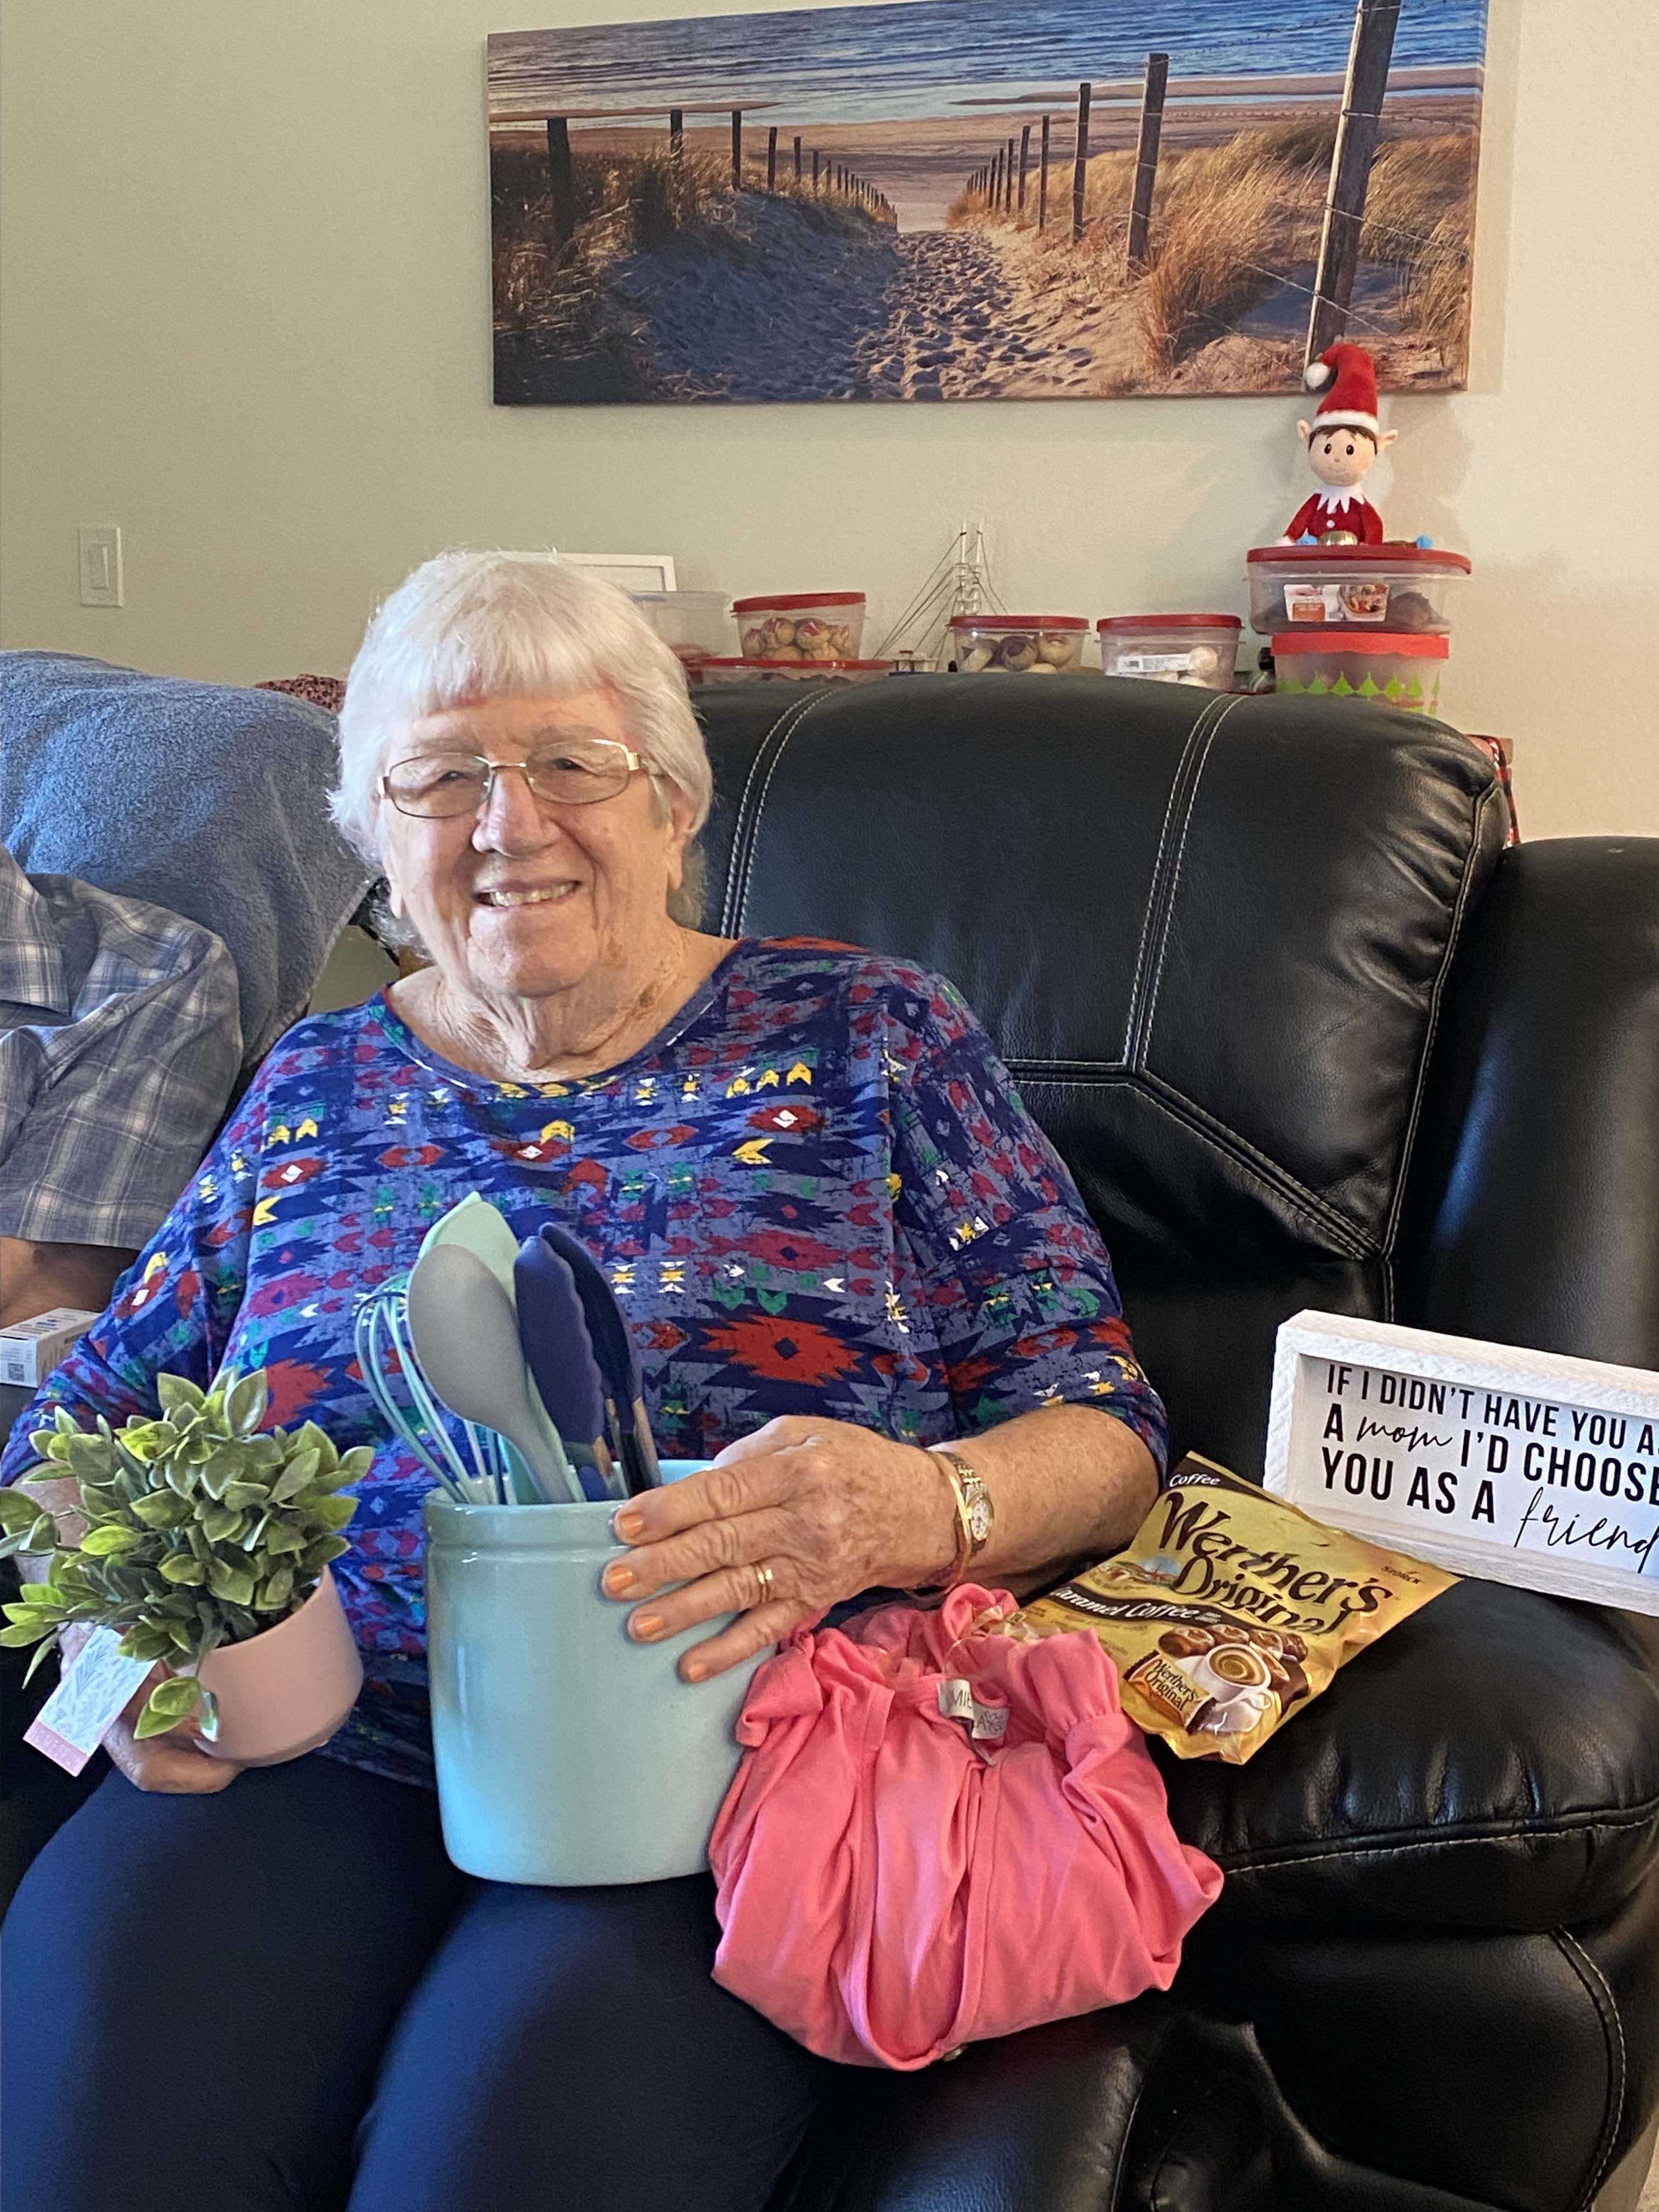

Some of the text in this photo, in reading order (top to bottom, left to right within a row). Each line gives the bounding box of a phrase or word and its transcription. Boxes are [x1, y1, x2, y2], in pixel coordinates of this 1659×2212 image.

[1328, 1364, 1659, 1455] IF I DIDN'T HAVE YOU A
[1169, 1473, 1221, 1487] Coffee
[1323, 1403, 1659, 1506] A mom I'D CHOOSE
[1322, 1446, 1659, 1574] YOU AS A friend
[1158, 1491, 1394, 1612] Werther's
[1125, 1602, 1200, 1618] Coffee
[1171, 1555, 1353, 1635] Original
[1144, 1669, 1189, 1711] Original
[1154, 1660, 1200, 1703] Werther's
